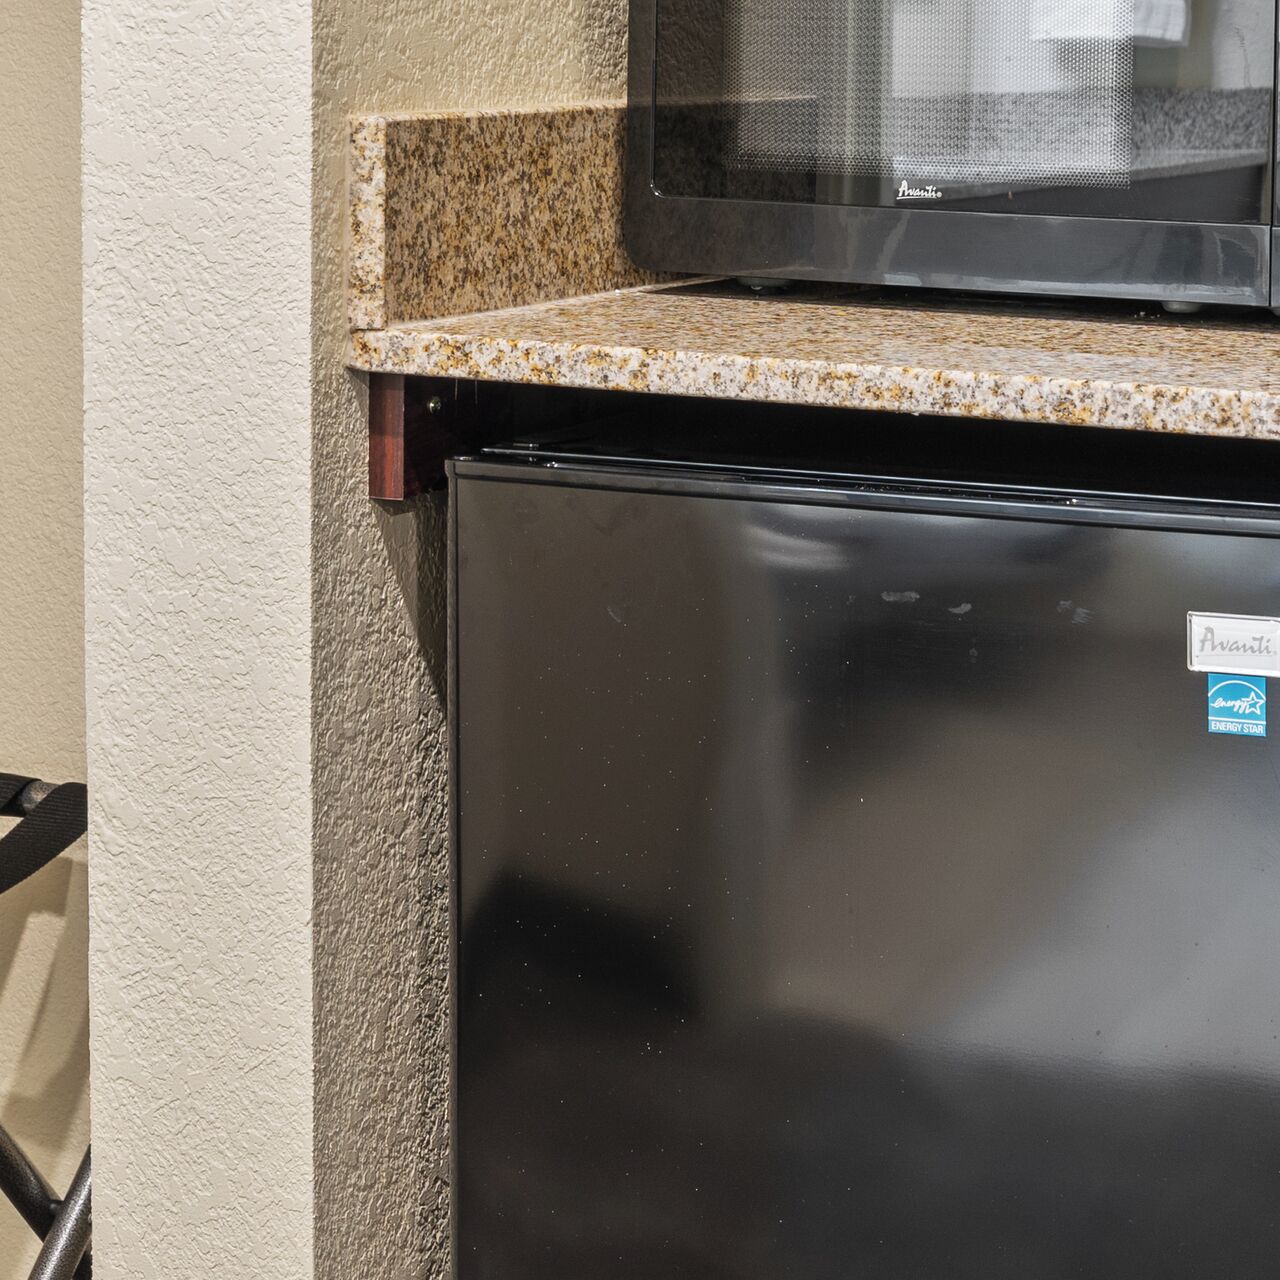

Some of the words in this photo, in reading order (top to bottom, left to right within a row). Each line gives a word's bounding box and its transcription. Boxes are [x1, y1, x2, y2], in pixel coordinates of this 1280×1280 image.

[897, 180, 937, 199] Avanti
[1199, 626, 1272, 655] Avanti
[1211, 722, 1242, 732] ENERGY
[1243, 723, 1264, 734] STAR
